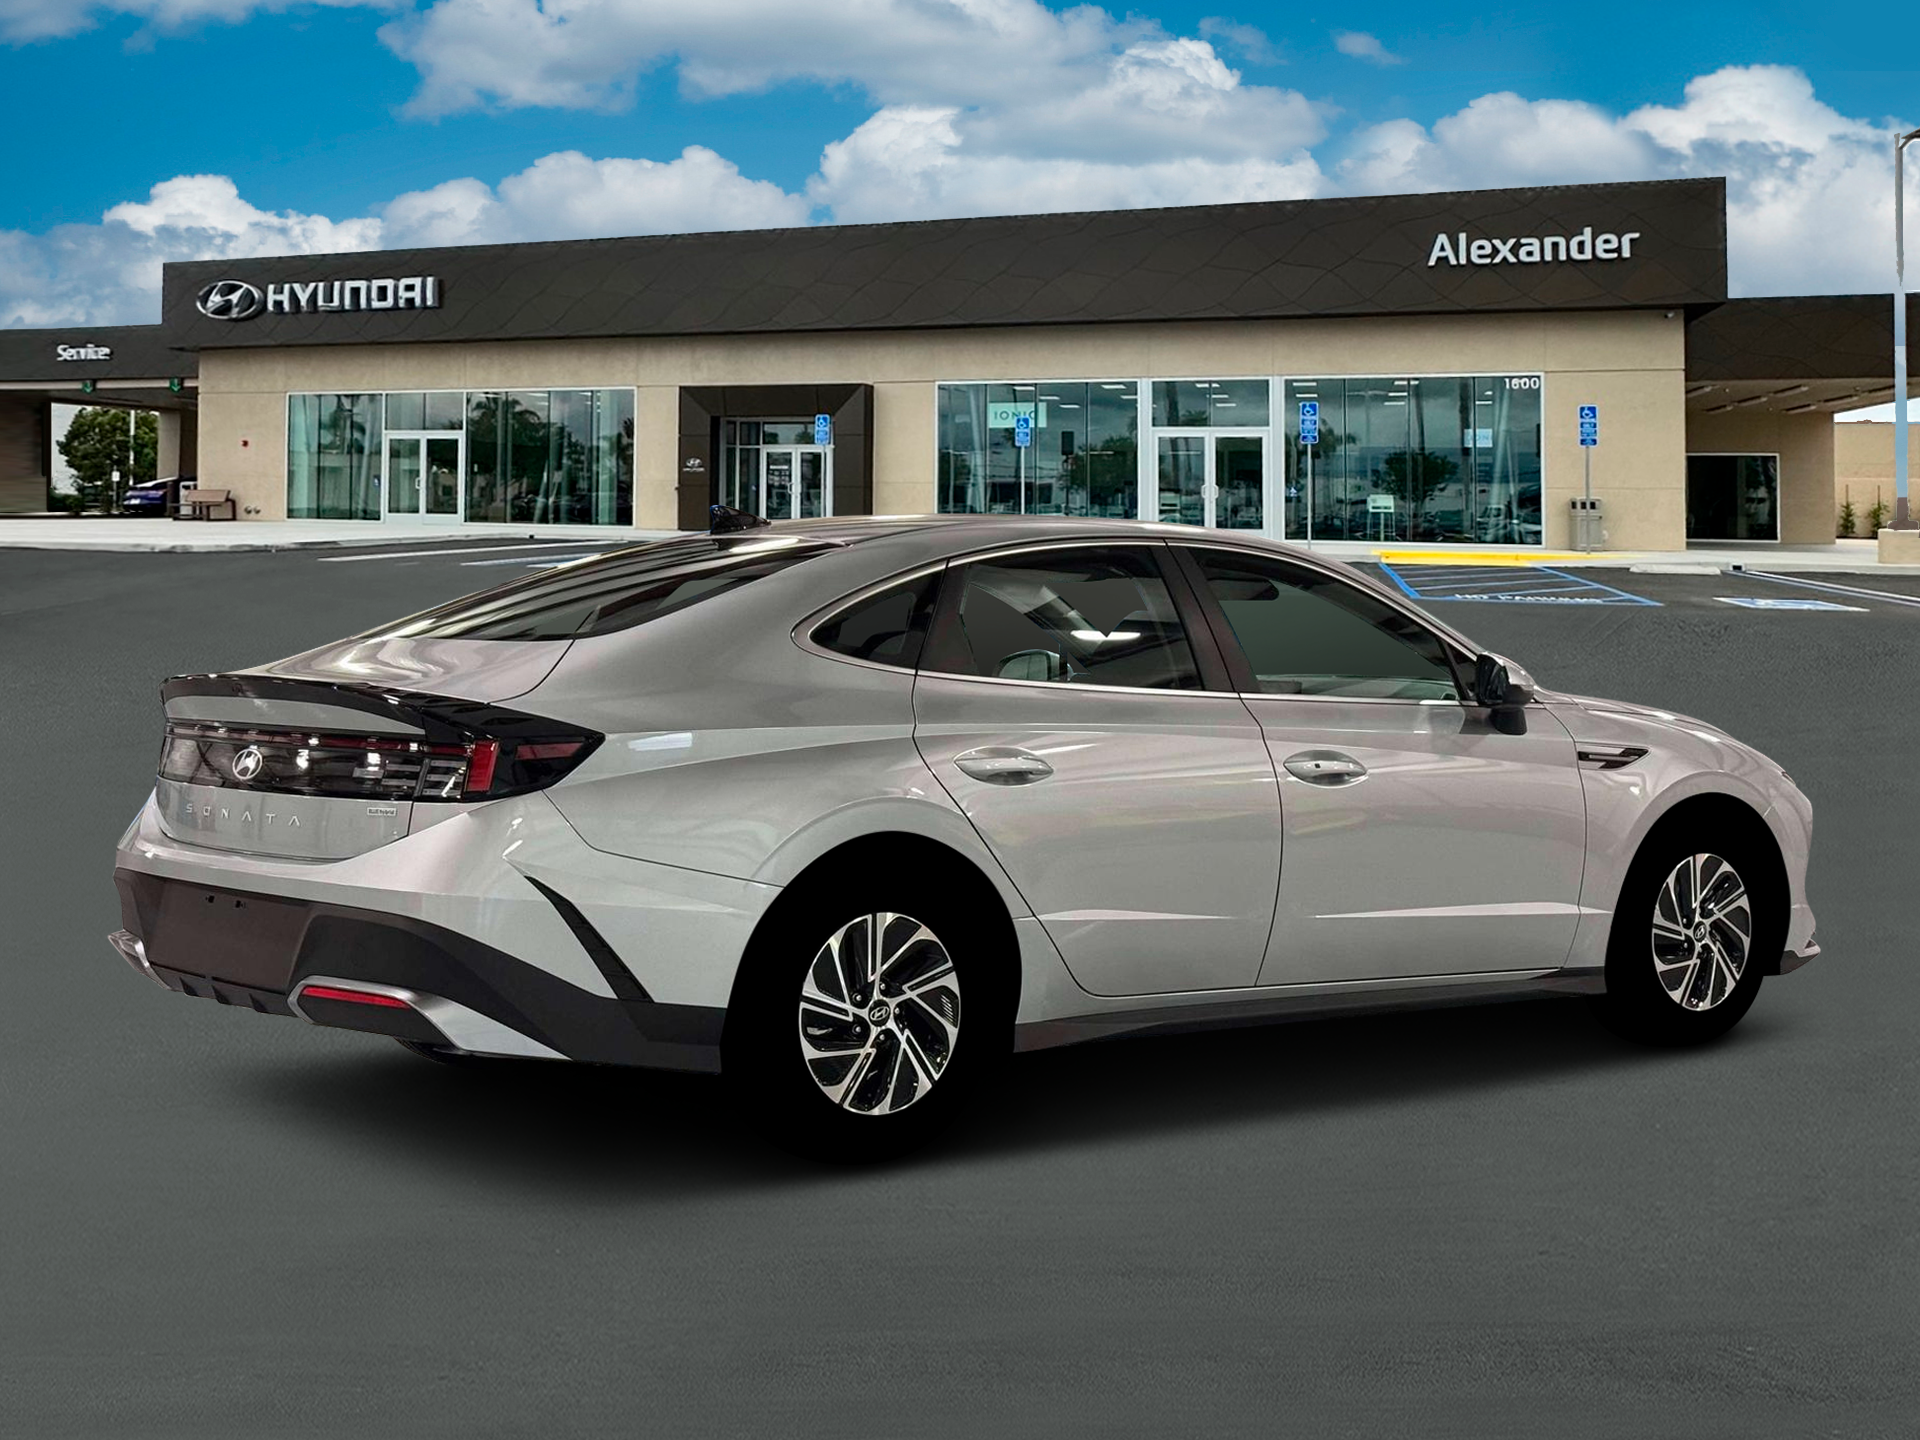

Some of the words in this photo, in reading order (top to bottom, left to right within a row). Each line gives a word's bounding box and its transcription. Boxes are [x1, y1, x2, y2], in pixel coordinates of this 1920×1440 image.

[1427, 226, 1641, 267] Alexander
[266, 276, 439, 313] HYUNDAI
[56, 343, 111, 361] Service
[1503, 377, 1540, 390] 1600
[186, 803, 300, 827] SONATA
